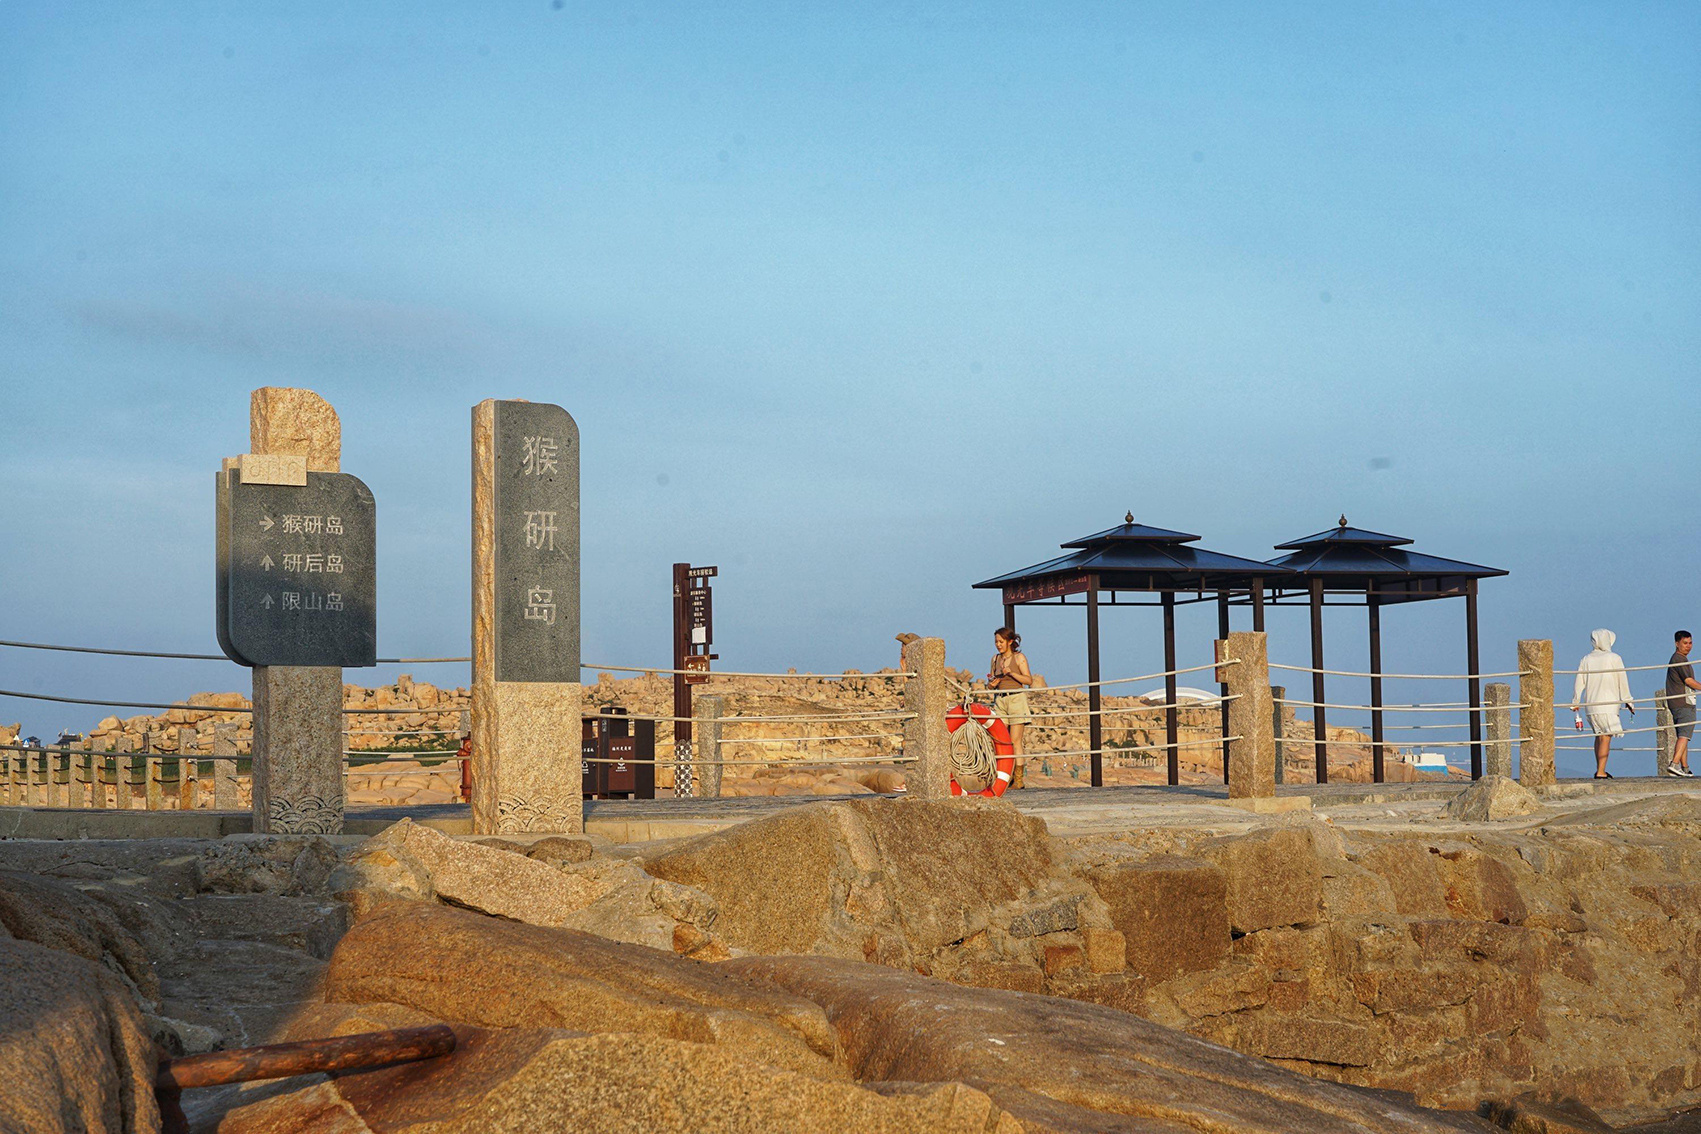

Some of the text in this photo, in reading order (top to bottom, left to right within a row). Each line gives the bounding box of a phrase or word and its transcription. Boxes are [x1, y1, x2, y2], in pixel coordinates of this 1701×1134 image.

[281, 513, 344, 536] 猴研岛
[522, 435, 558, 626] 猴研岛
[281, 552, 345, 574] 研后岛
[281, 591, 344, 612] 限山岛
